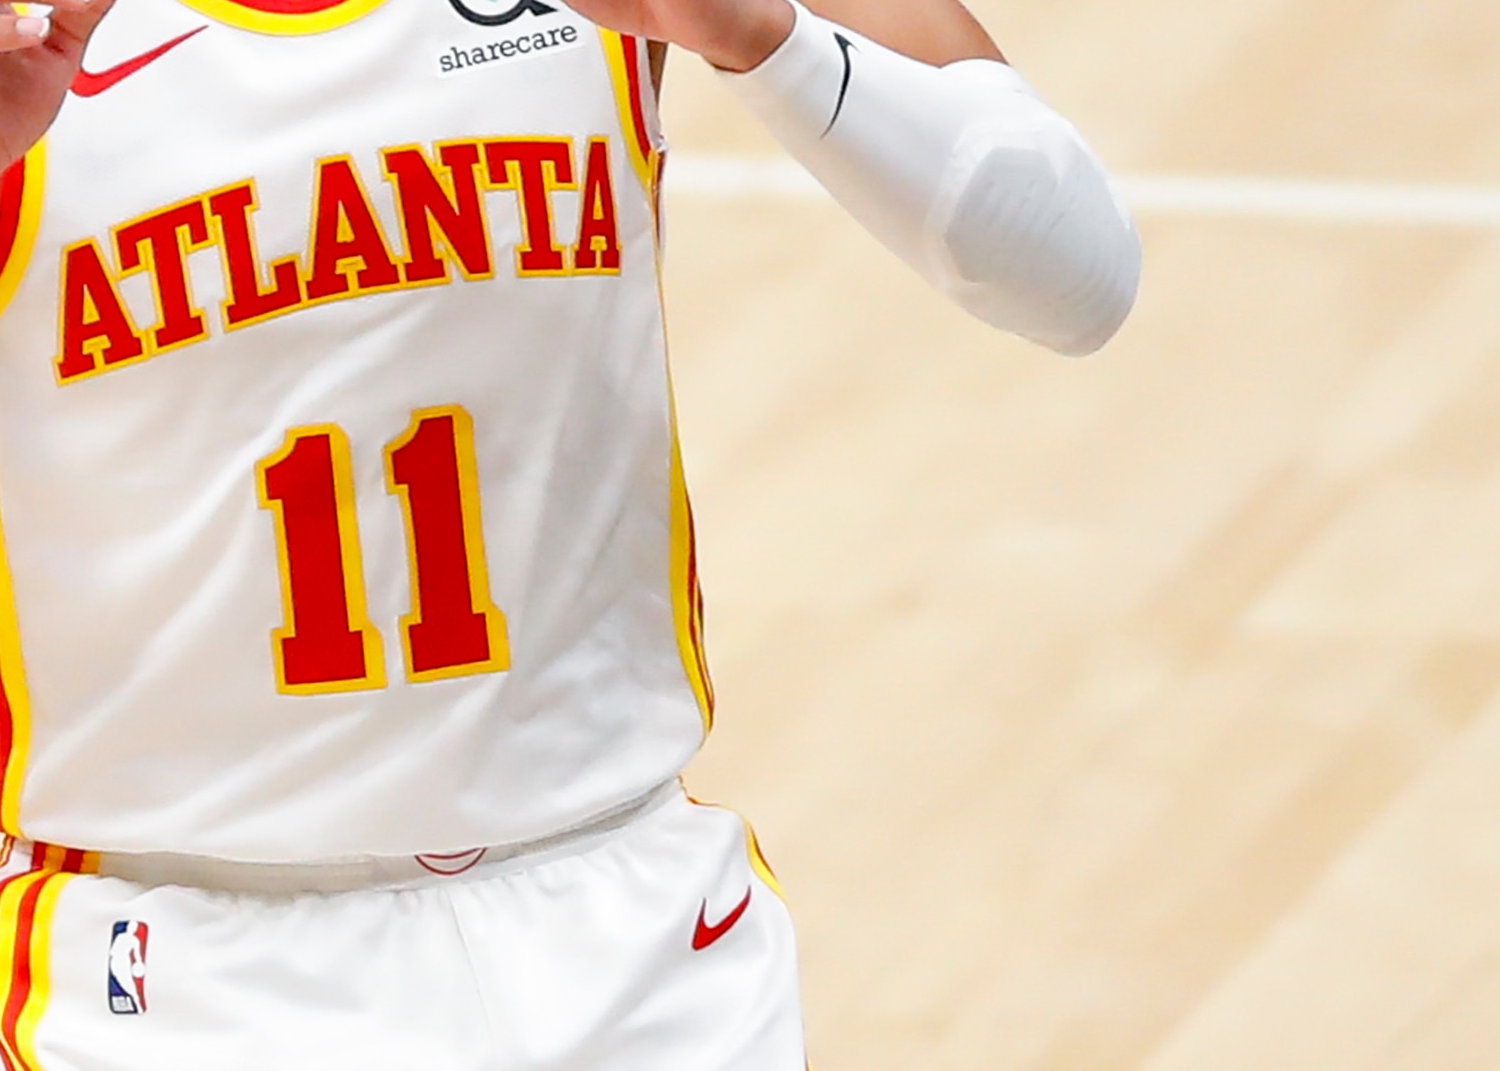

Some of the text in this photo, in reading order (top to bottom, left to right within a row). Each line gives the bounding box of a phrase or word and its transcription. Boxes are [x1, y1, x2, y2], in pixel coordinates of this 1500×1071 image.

[439, 25, 578, 72] sharecare
[53, 135, 622, 387] ATLANTA
[255, 403, 511, 695] 11
